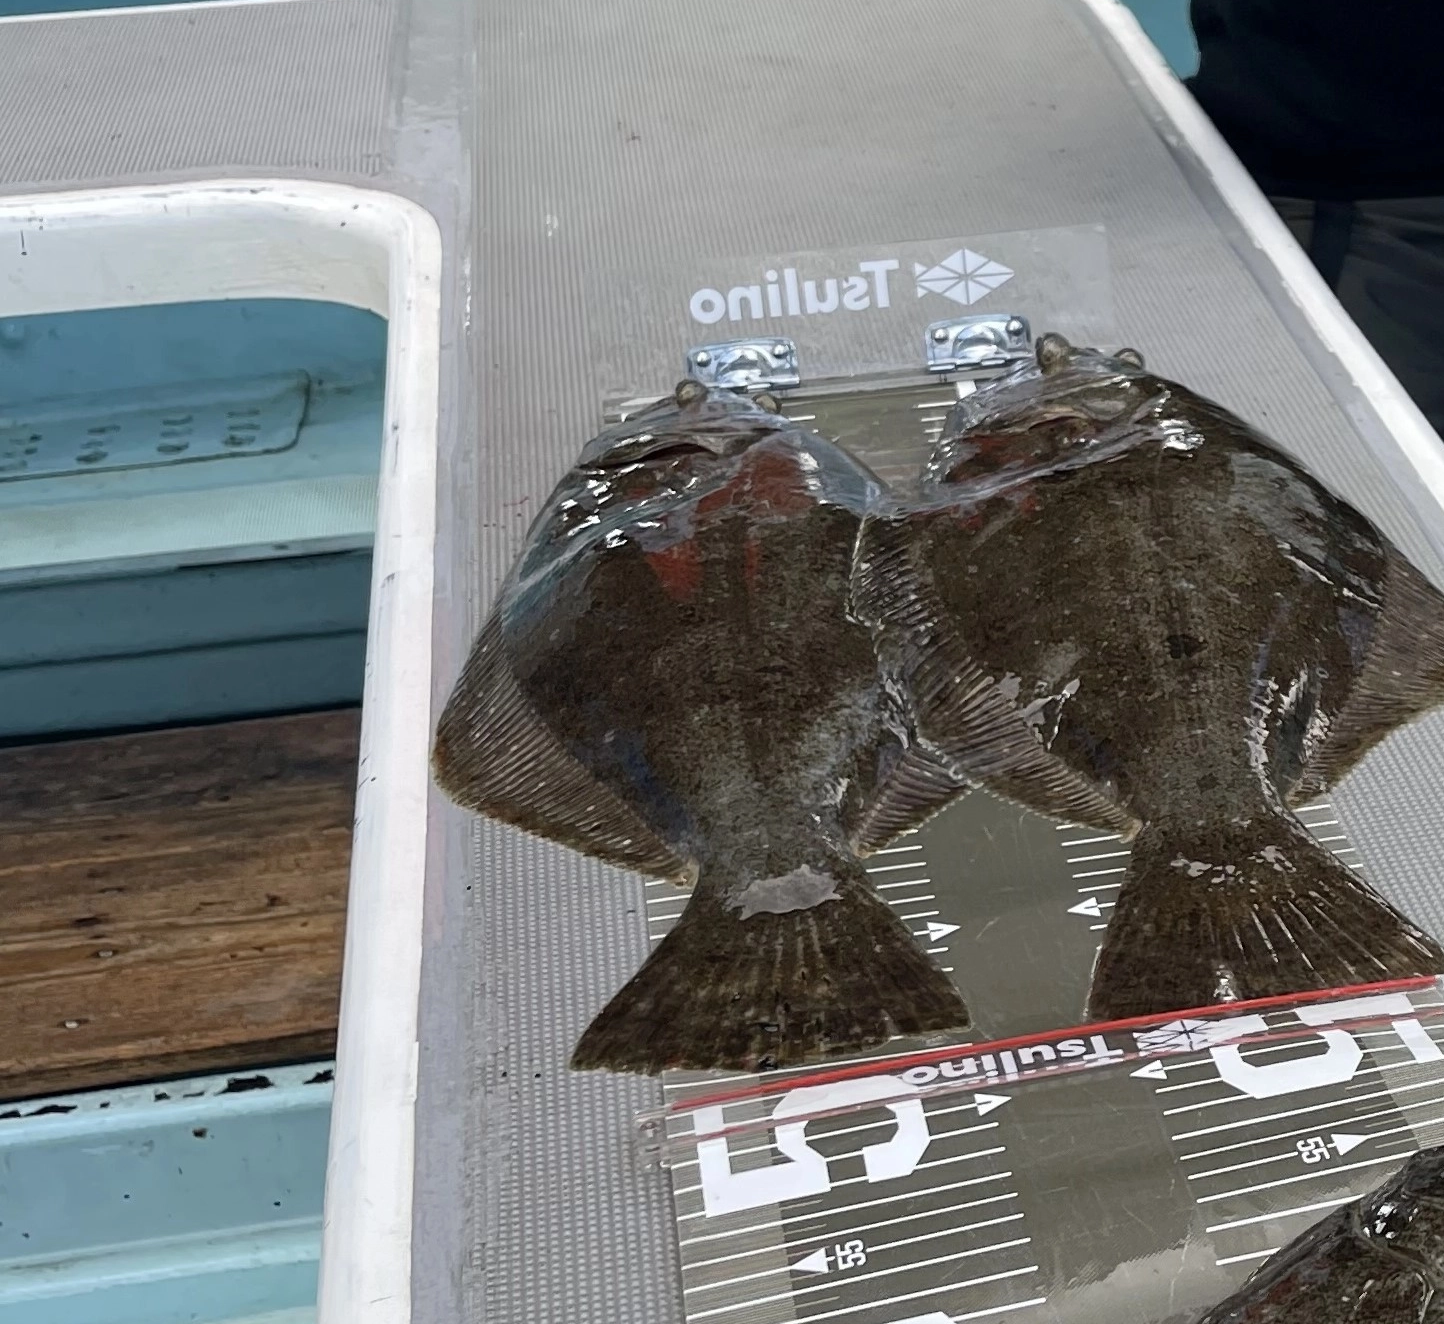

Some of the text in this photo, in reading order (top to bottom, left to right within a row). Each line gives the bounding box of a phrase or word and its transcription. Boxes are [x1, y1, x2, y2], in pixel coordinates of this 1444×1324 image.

[900, 1032, 1124, 1085] Tsulino
[1209, 993, 1444, 1099] 5
[693, 1074, 930, 1217] 5
[1296, 1135, 1331, 1165] 55
[837, 1239, 867, 1270] 55
